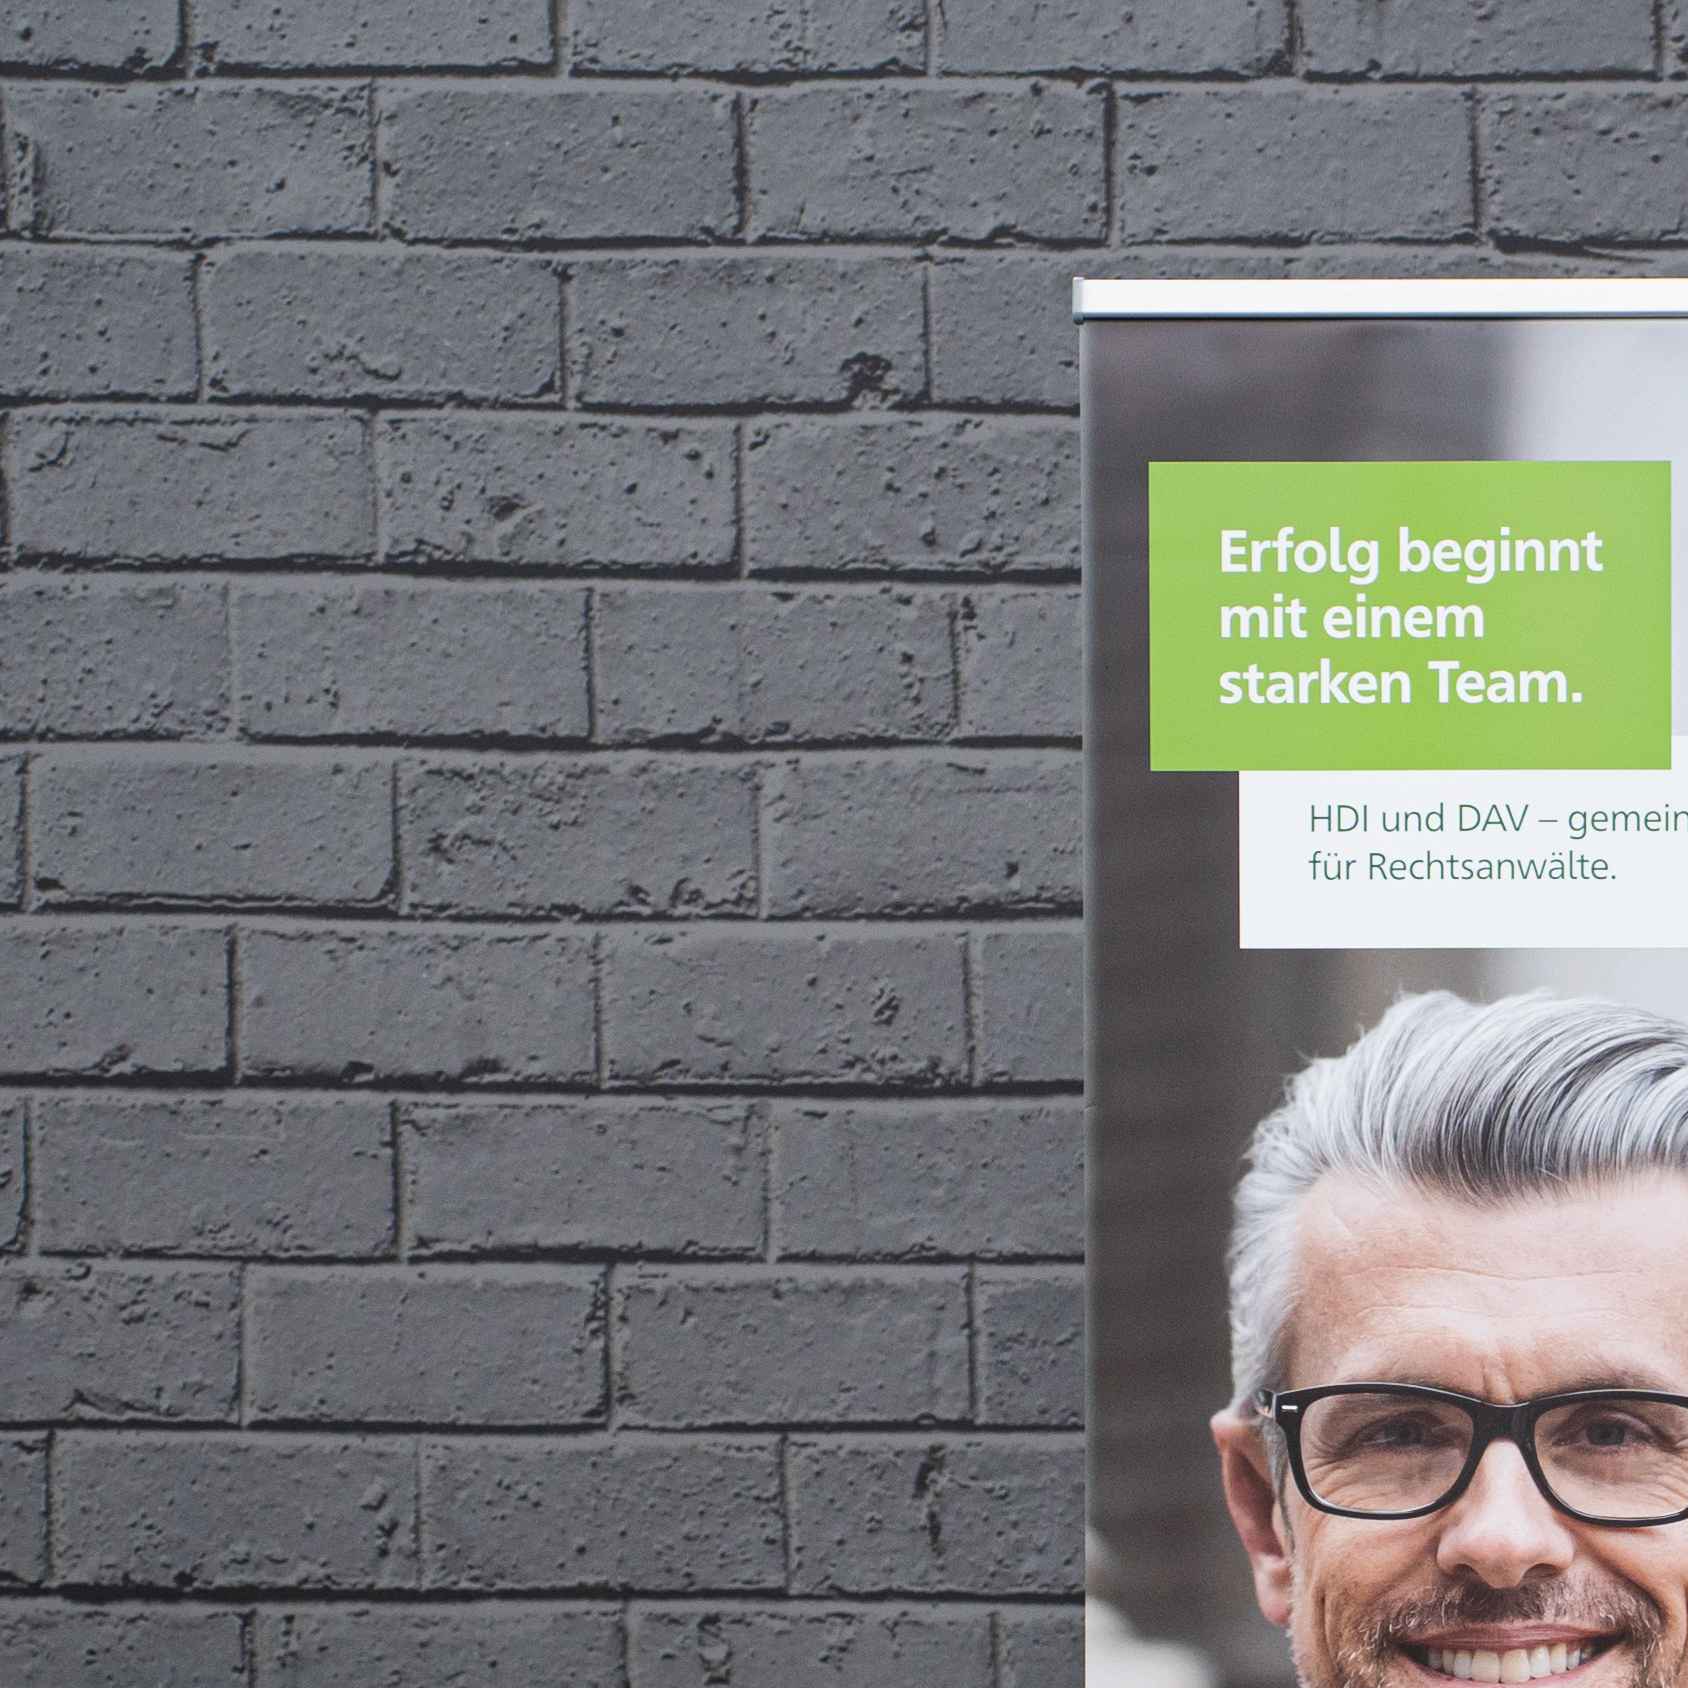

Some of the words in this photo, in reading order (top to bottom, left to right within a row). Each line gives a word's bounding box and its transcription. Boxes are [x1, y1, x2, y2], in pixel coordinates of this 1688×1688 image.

[1218, 526, 1381, 585] Erfolg
[1398, 526, 1604, 585] beginnt
[1218, 593, 1308, 638] mit
[1322, 593, 1485, 638] einem
[1218, 657, 1412, 704] starken
[1427, 660, 1583, 703] Team.
[1309, 804, 1369, 833] HDI
[1381, 802, 1445, 833] und
[1457, 804, 1529, 832] DAV
[1308, 850, 1357, 881] für
[1367, 849, 1617, 881] Rechtsanwälte.
